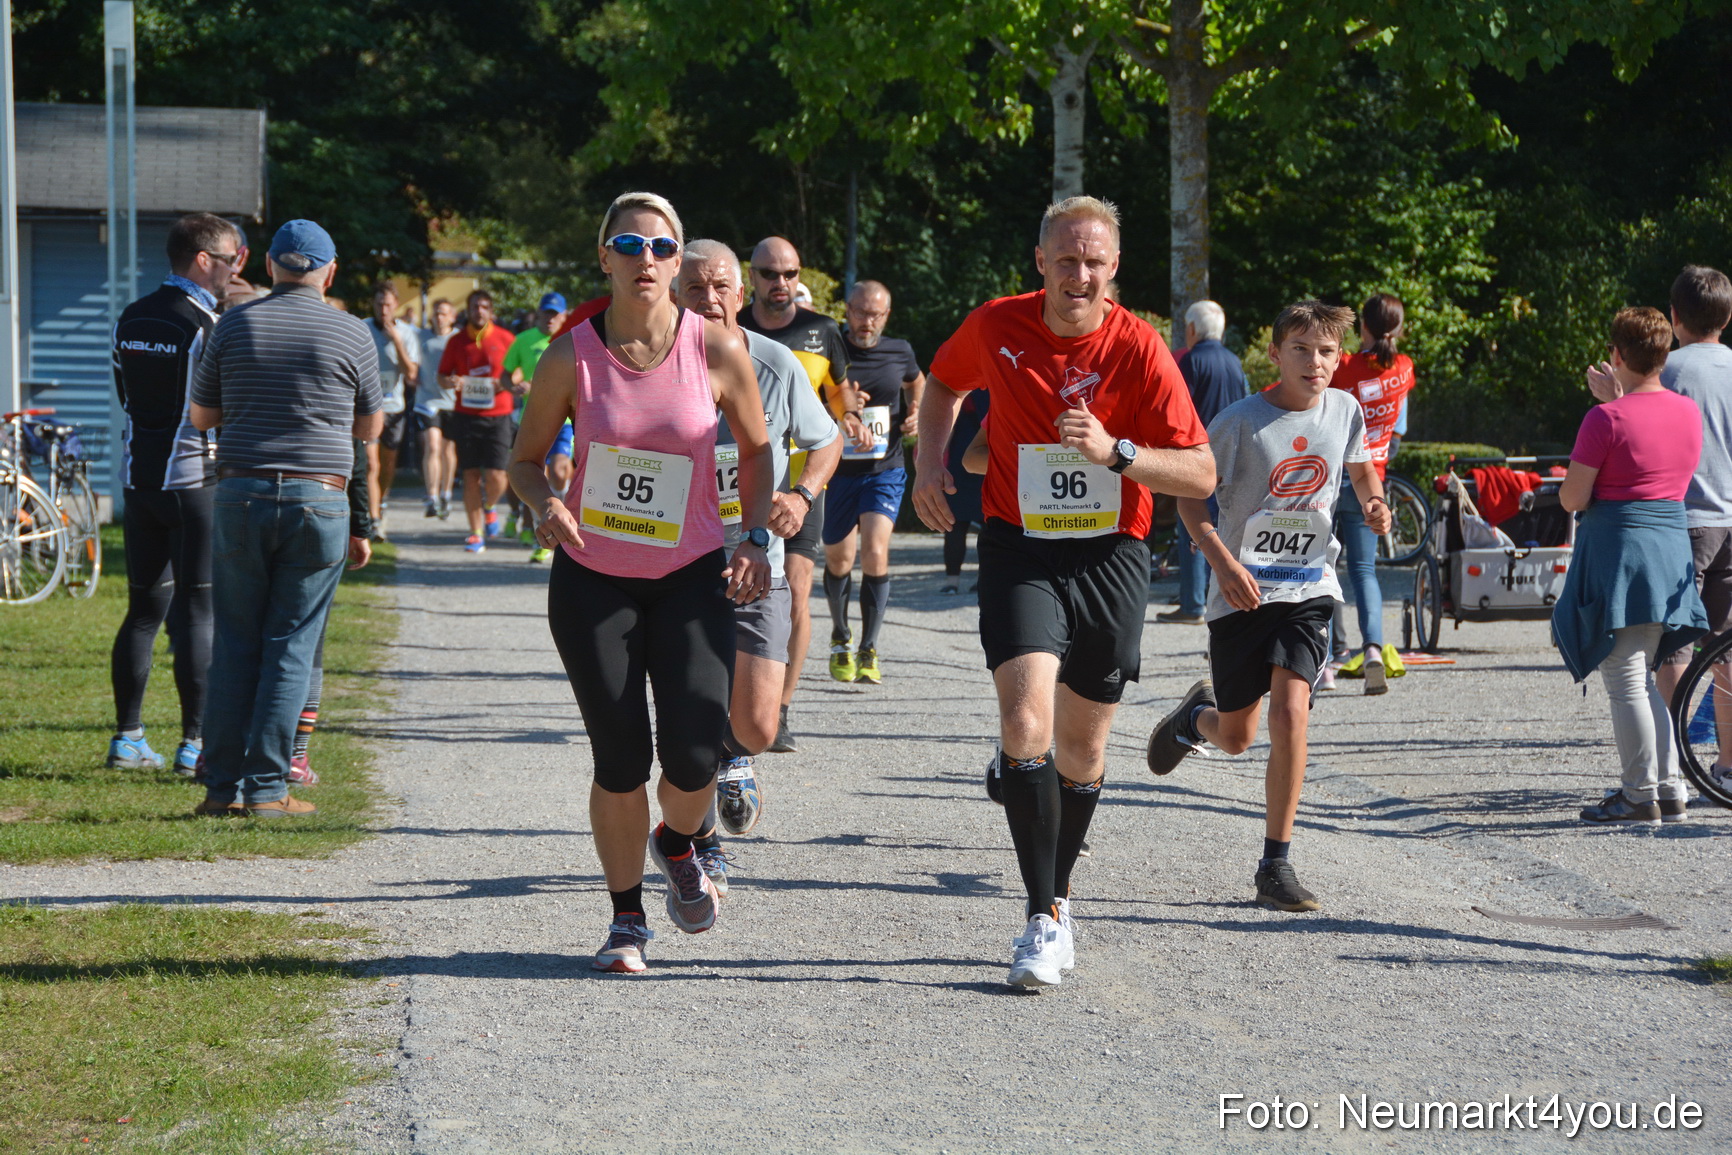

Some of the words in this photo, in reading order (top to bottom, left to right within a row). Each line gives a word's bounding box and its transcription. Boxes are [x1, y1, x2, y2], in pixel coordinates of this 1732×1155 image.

[1364, 400, 1396, 419] box
[617, 455, 662, 471] BOCK
[617, 473, 655, 504] 95
[1050, 470, 1087, 500] 96
[602, 501, 624, 511] PARTL
[624, 505, 655, 516] Neumarkt
[604, 515, 656, 535] Manuela
[1043, 516, 1097, 529] Christian
[1271, 517, 1309, 527] BOCK
[1253, 530, 1317, 556] 2047
[1257, 567, 1305, 580] Korbinian
